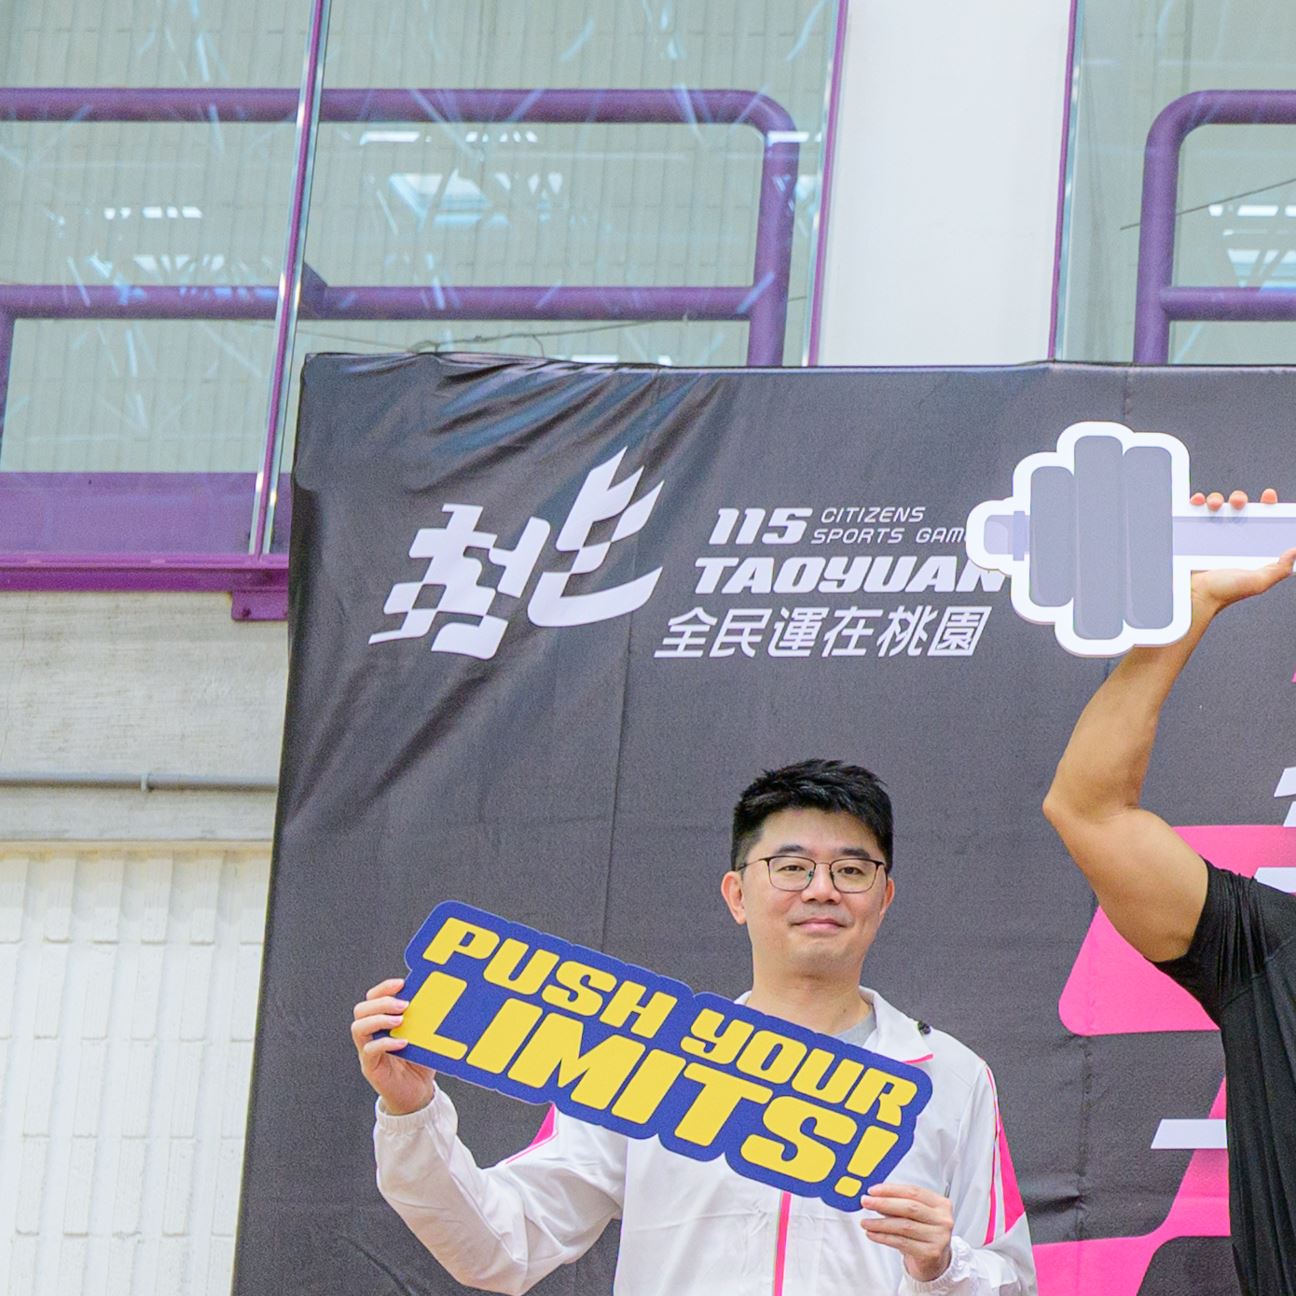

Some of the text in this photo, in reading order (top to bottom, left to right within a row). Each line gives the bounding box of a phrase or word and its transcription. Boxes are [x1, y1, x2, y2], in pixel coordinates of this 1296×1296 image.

[709, 507, 926, 544] 115 CITIZENS
[811, 527, 967, 544] SPORTS GAM
[653, 605, 993, 659] 全民運在桃園
[423, 917, 918, 1126] PUSH YOUR
[390, 970, 899, 1198] LIMITS!
